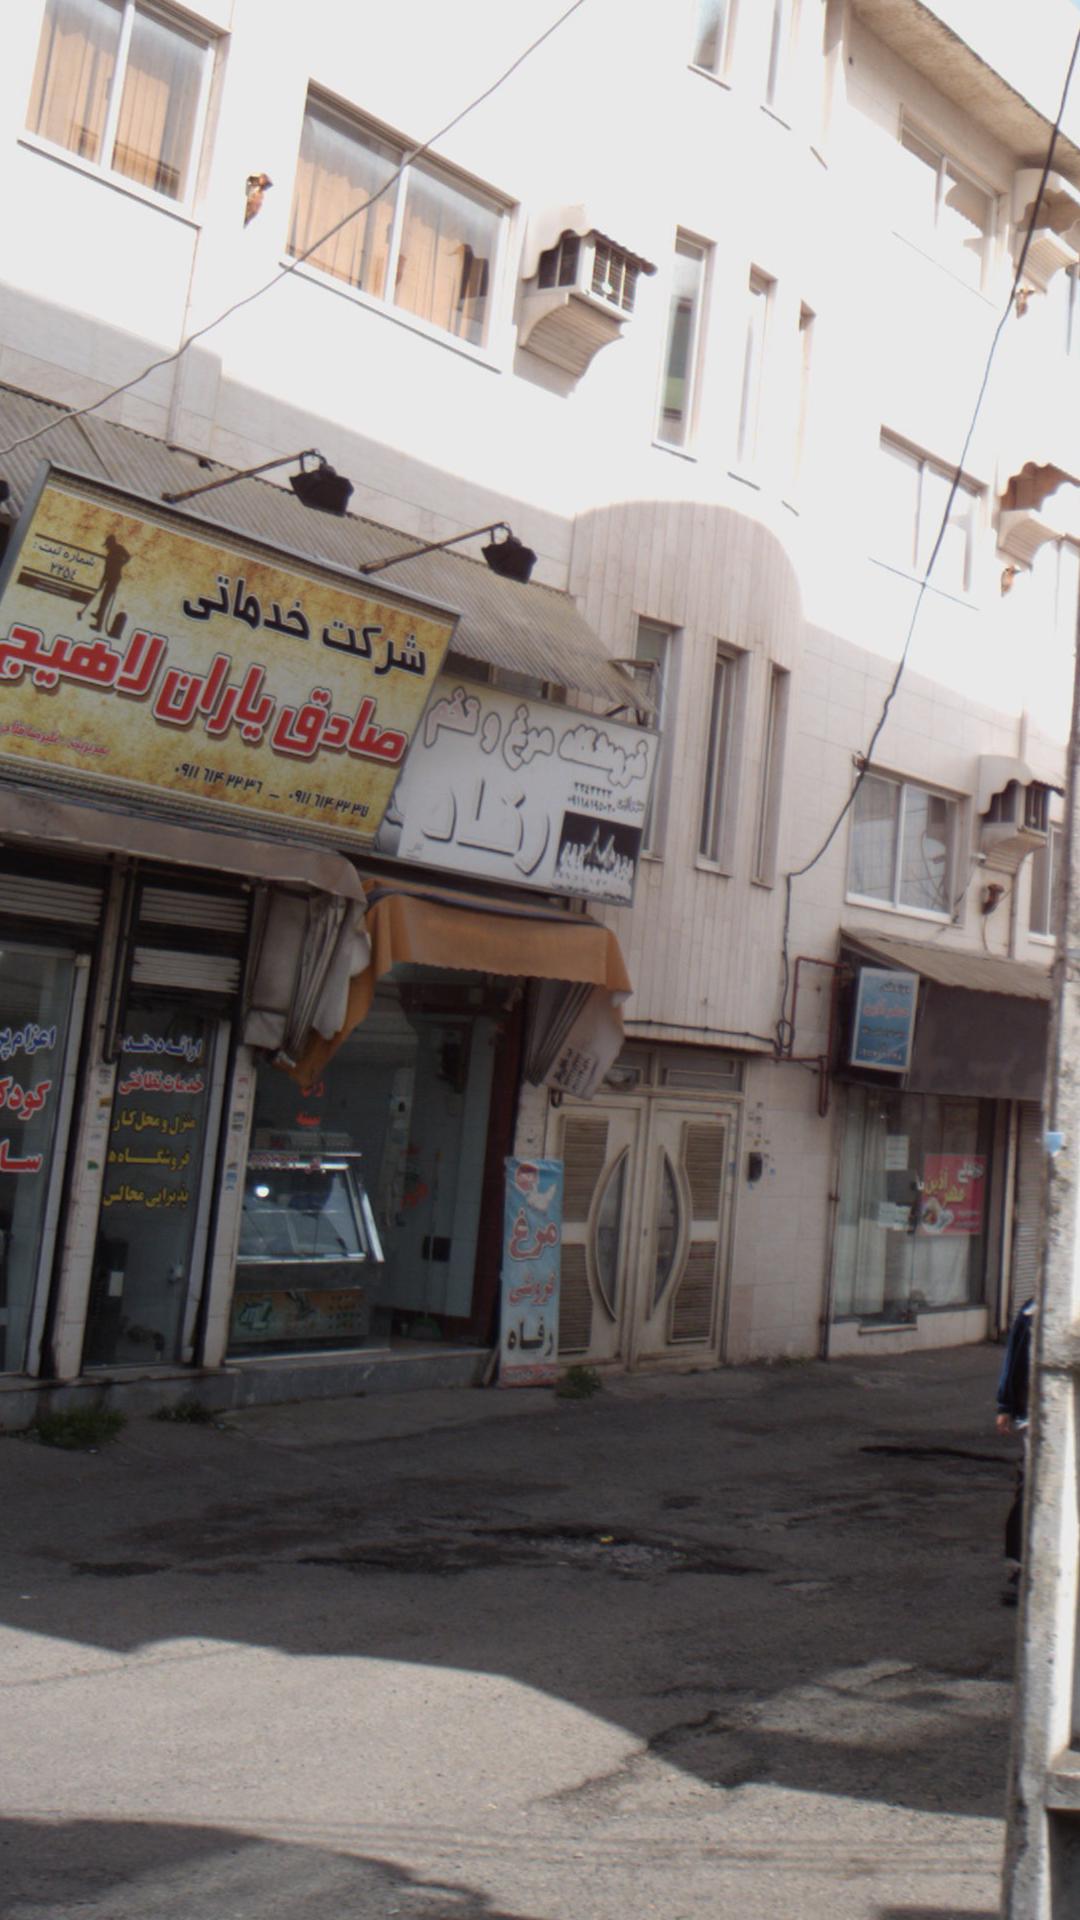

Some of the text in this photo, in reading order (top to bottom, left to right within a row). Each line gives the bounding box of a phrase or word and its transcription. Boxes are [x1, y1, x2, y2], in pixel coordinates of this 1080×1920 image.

[182, 574, 427, 677] شرکت خدماتی
[153, 652, 276, 743] یاران
[271, 685, 409, 763] صادق
[12, 1022, 57, 1055] اعزام
[112, 1110, 138, 1132] کار
[168, 1115, 197, 1136] منزل
[508, 1206, 559, 1261] مرغ
[507, 1316, 554, 1357] رفاه
